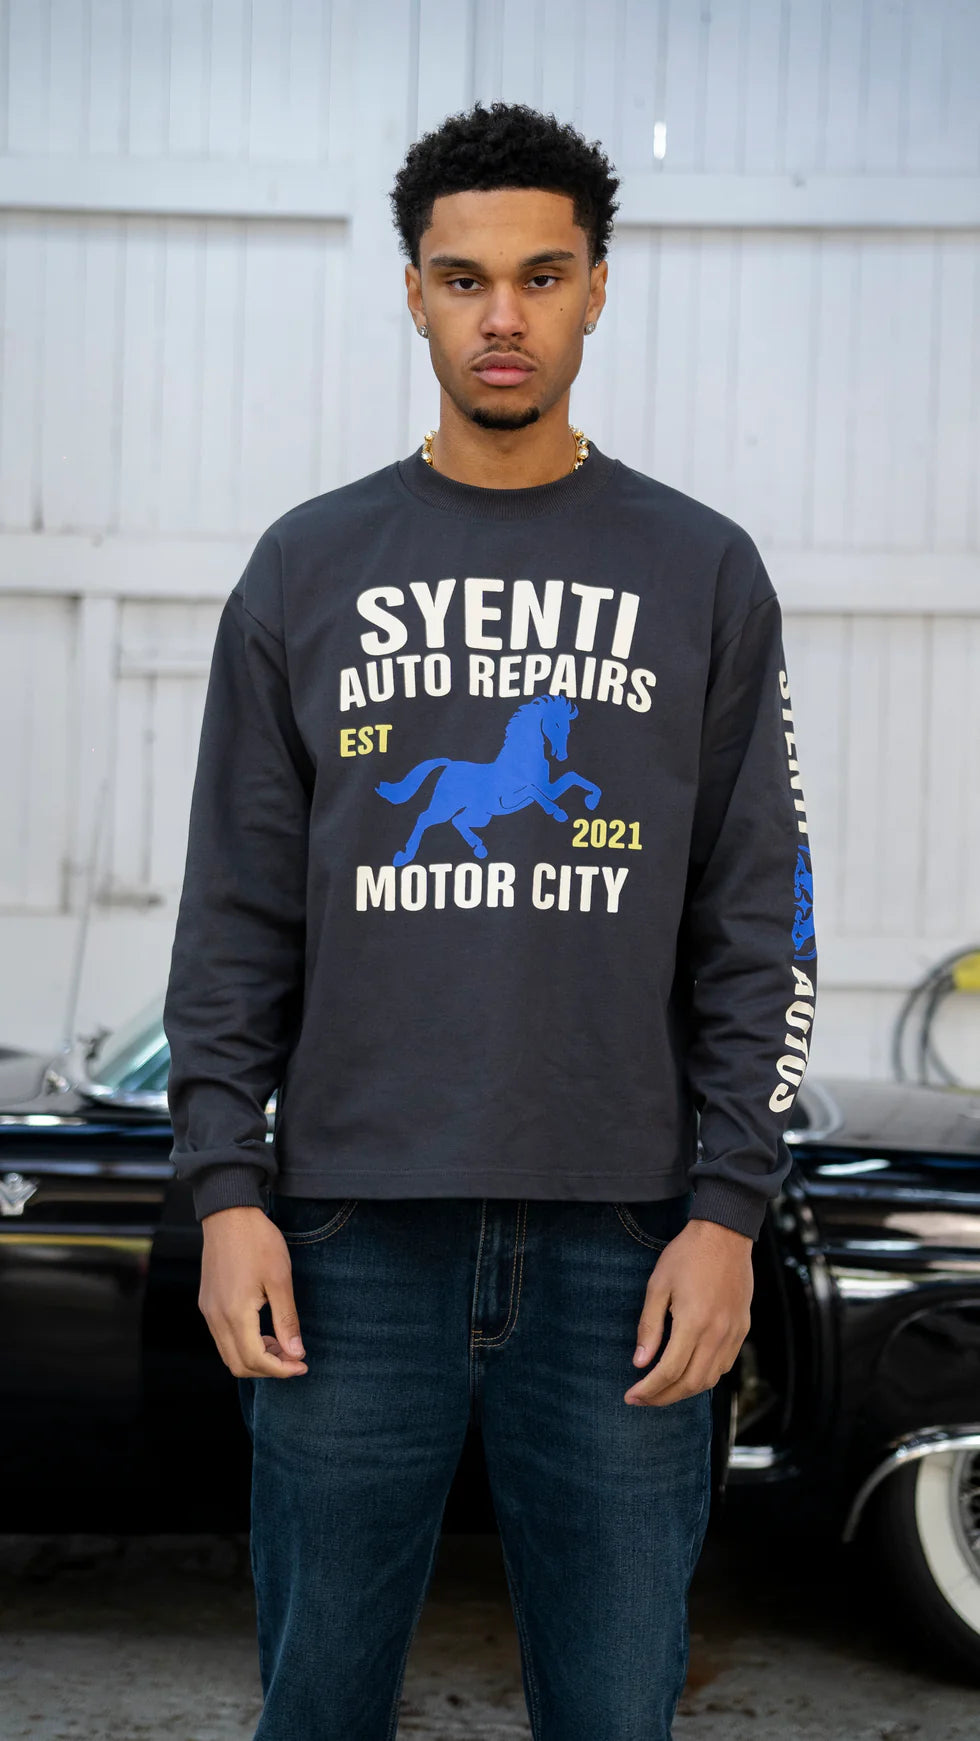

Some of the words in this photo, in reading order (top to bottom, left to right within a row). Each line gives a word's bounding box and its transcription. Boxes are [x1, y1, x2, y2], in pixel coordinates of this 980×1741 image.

[356, 577, 641, 660] SYENTI
[339, 653, 453, 712] AUTO
[468, 653, 657, 713] REPAIRS
[339, 723, 393, 758] EST
[571, 818, 643, 851] 2021
[355, 862, 516, 912] MOTOR
[531, 862, 630, 913] CITY
